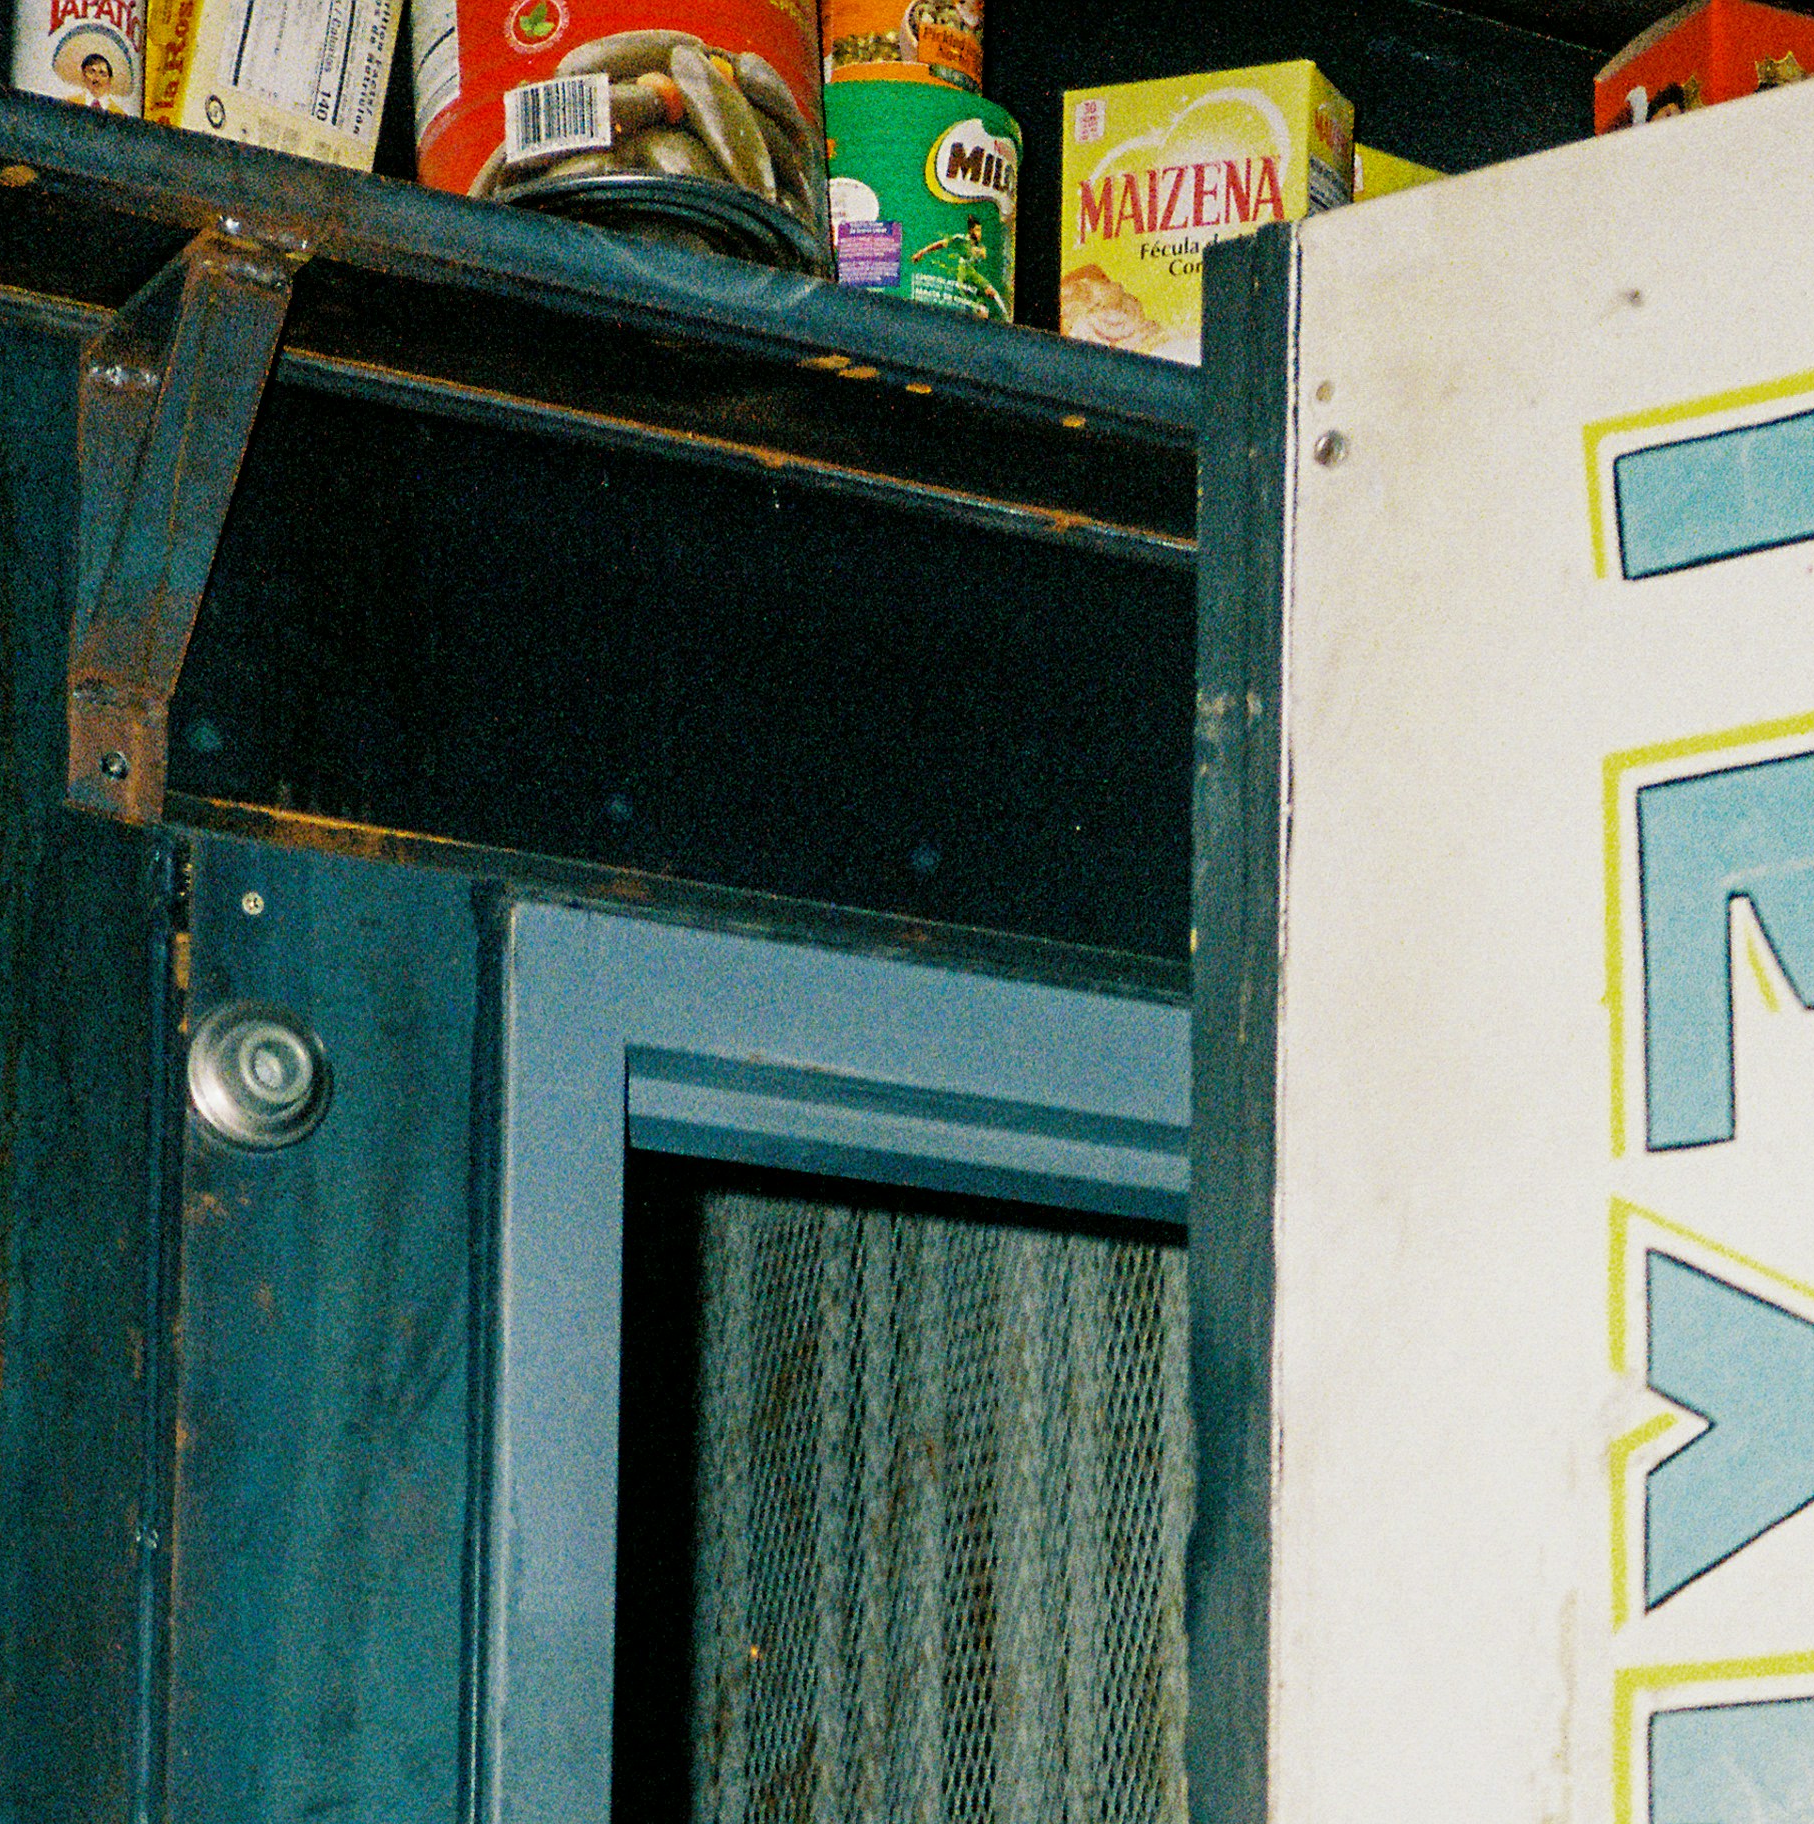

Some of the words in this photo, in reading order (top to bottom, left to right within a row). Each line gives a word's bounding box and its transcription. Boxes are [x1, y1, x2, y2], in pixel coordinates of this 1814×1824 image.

[314, 90, 333, 122] 140
[1077, 154, 1286, 246] MAIZENA
[1139, 236, 1200, 261] Fécula
